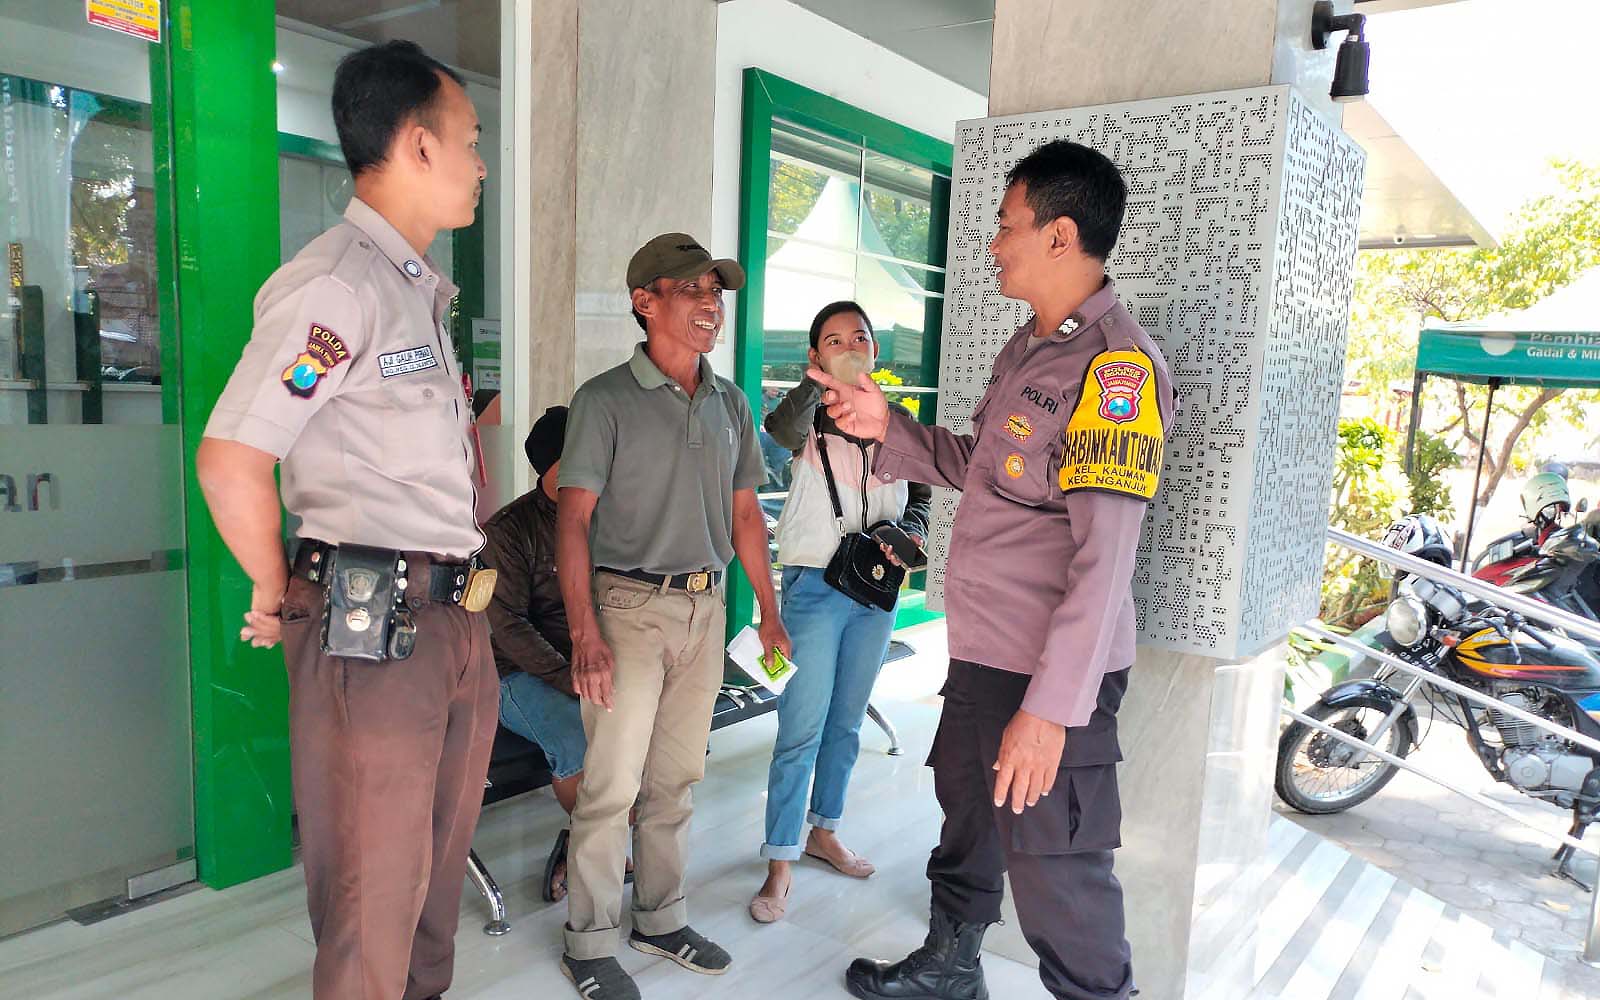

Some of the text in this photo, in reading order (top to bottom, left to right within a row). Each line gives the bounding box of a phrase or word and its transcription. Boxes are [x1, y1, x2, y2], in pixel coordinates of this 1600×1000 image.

[312, 326, 347, 358] POLDA
[1567, 349, 1578, 360] &
[1020, 385, 1059, 415] POLRI
[1067, 474, 1092, 486] KEC.
[1102, 466, 1146, 483] KAUMAN
